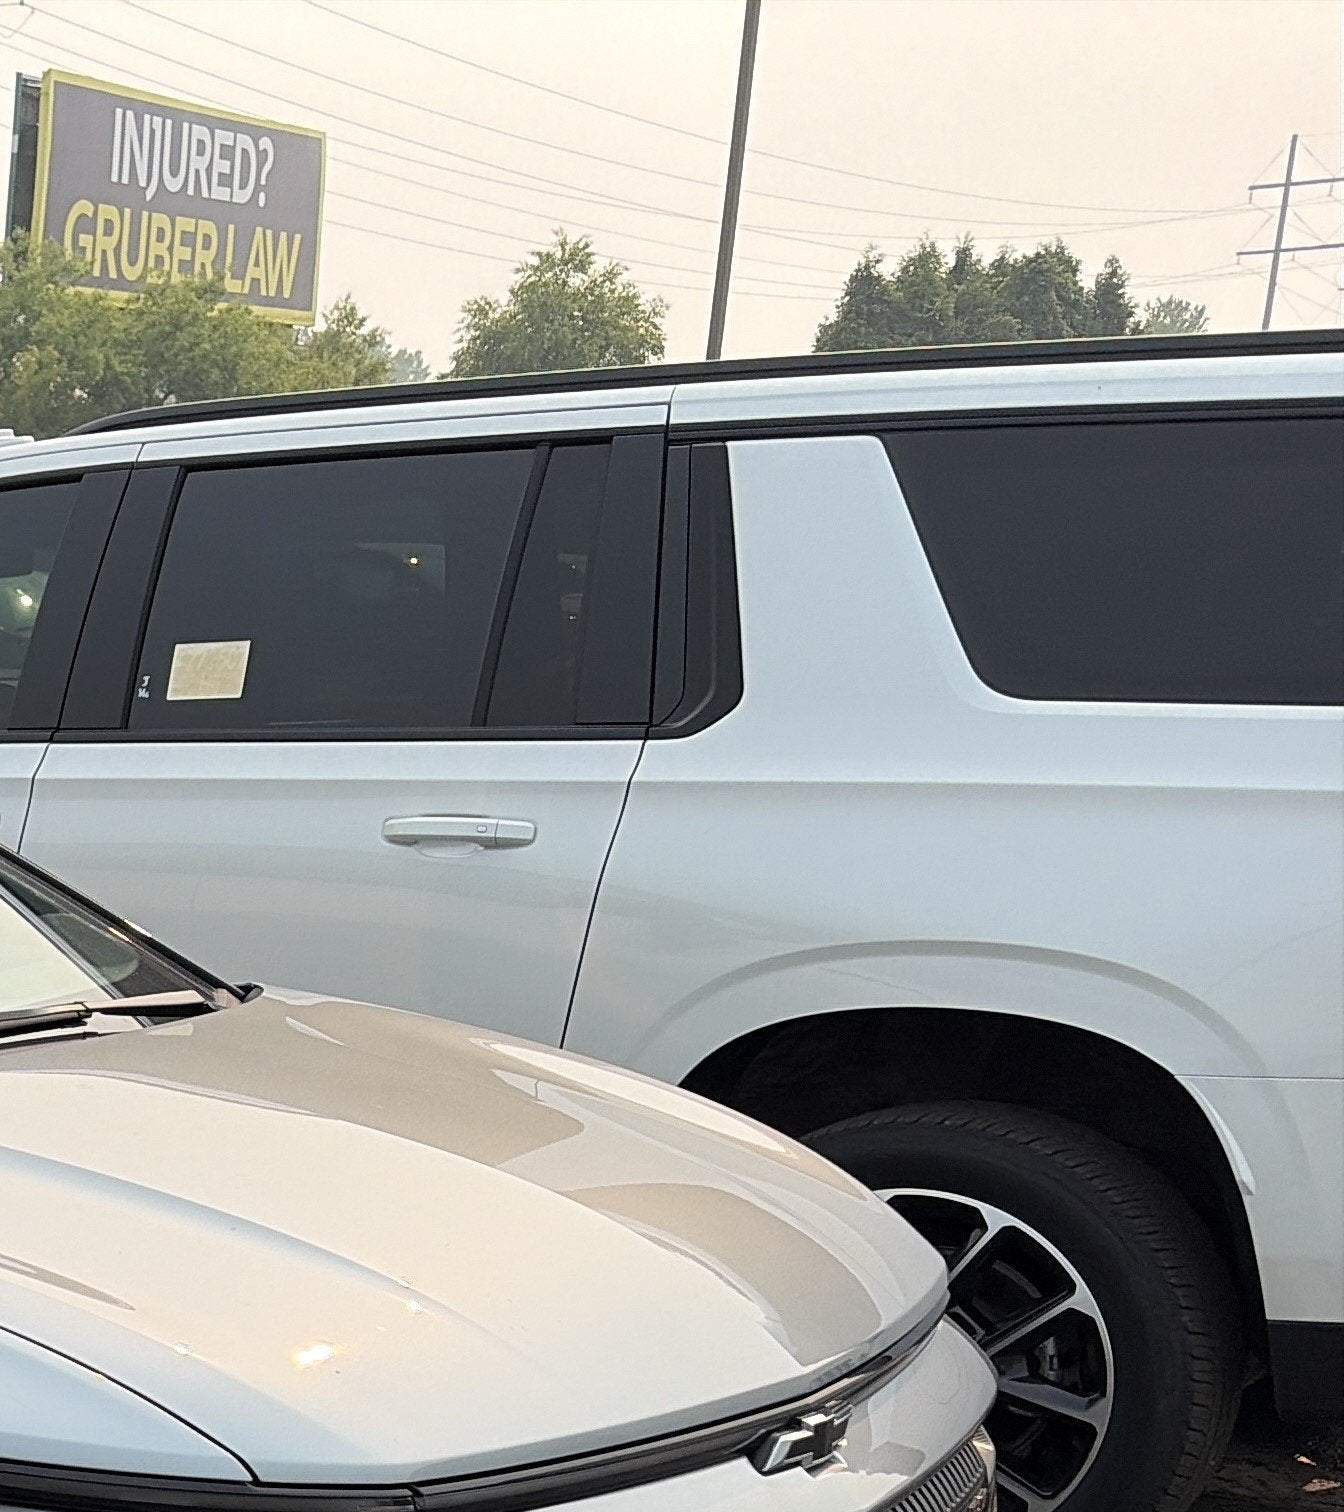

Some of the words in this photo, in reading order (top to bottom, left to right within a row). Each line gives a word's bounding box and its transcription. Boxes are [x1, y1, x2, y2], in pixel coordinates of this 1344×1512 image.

[111, 107, 274, 207] INJURED?
[64, 199, 218, 286] GRUBER
[224, 223, 302, 299] LAW
